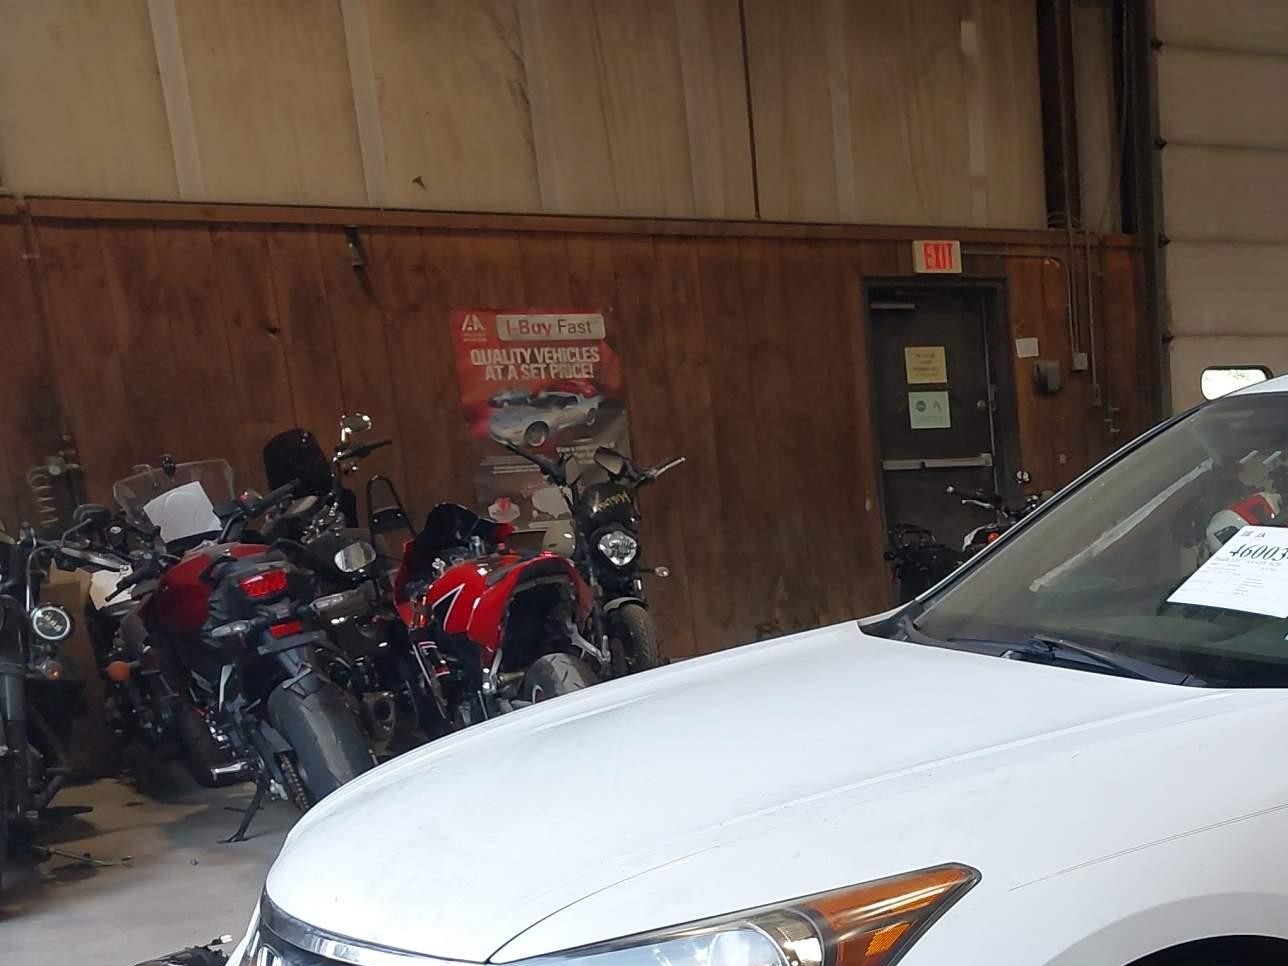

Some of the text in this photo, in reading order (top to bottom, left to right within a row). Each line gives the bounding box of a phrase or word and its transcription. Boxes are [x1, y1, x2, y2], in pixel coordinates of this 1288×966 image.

[924, 243, 953, 270] EXIT
[506, 320, 551, 336] I-Buy
[470, 346, 600, 365] QUALITY VEHICLES
[485, 362, 594, 380] AT A SET PRICE!
